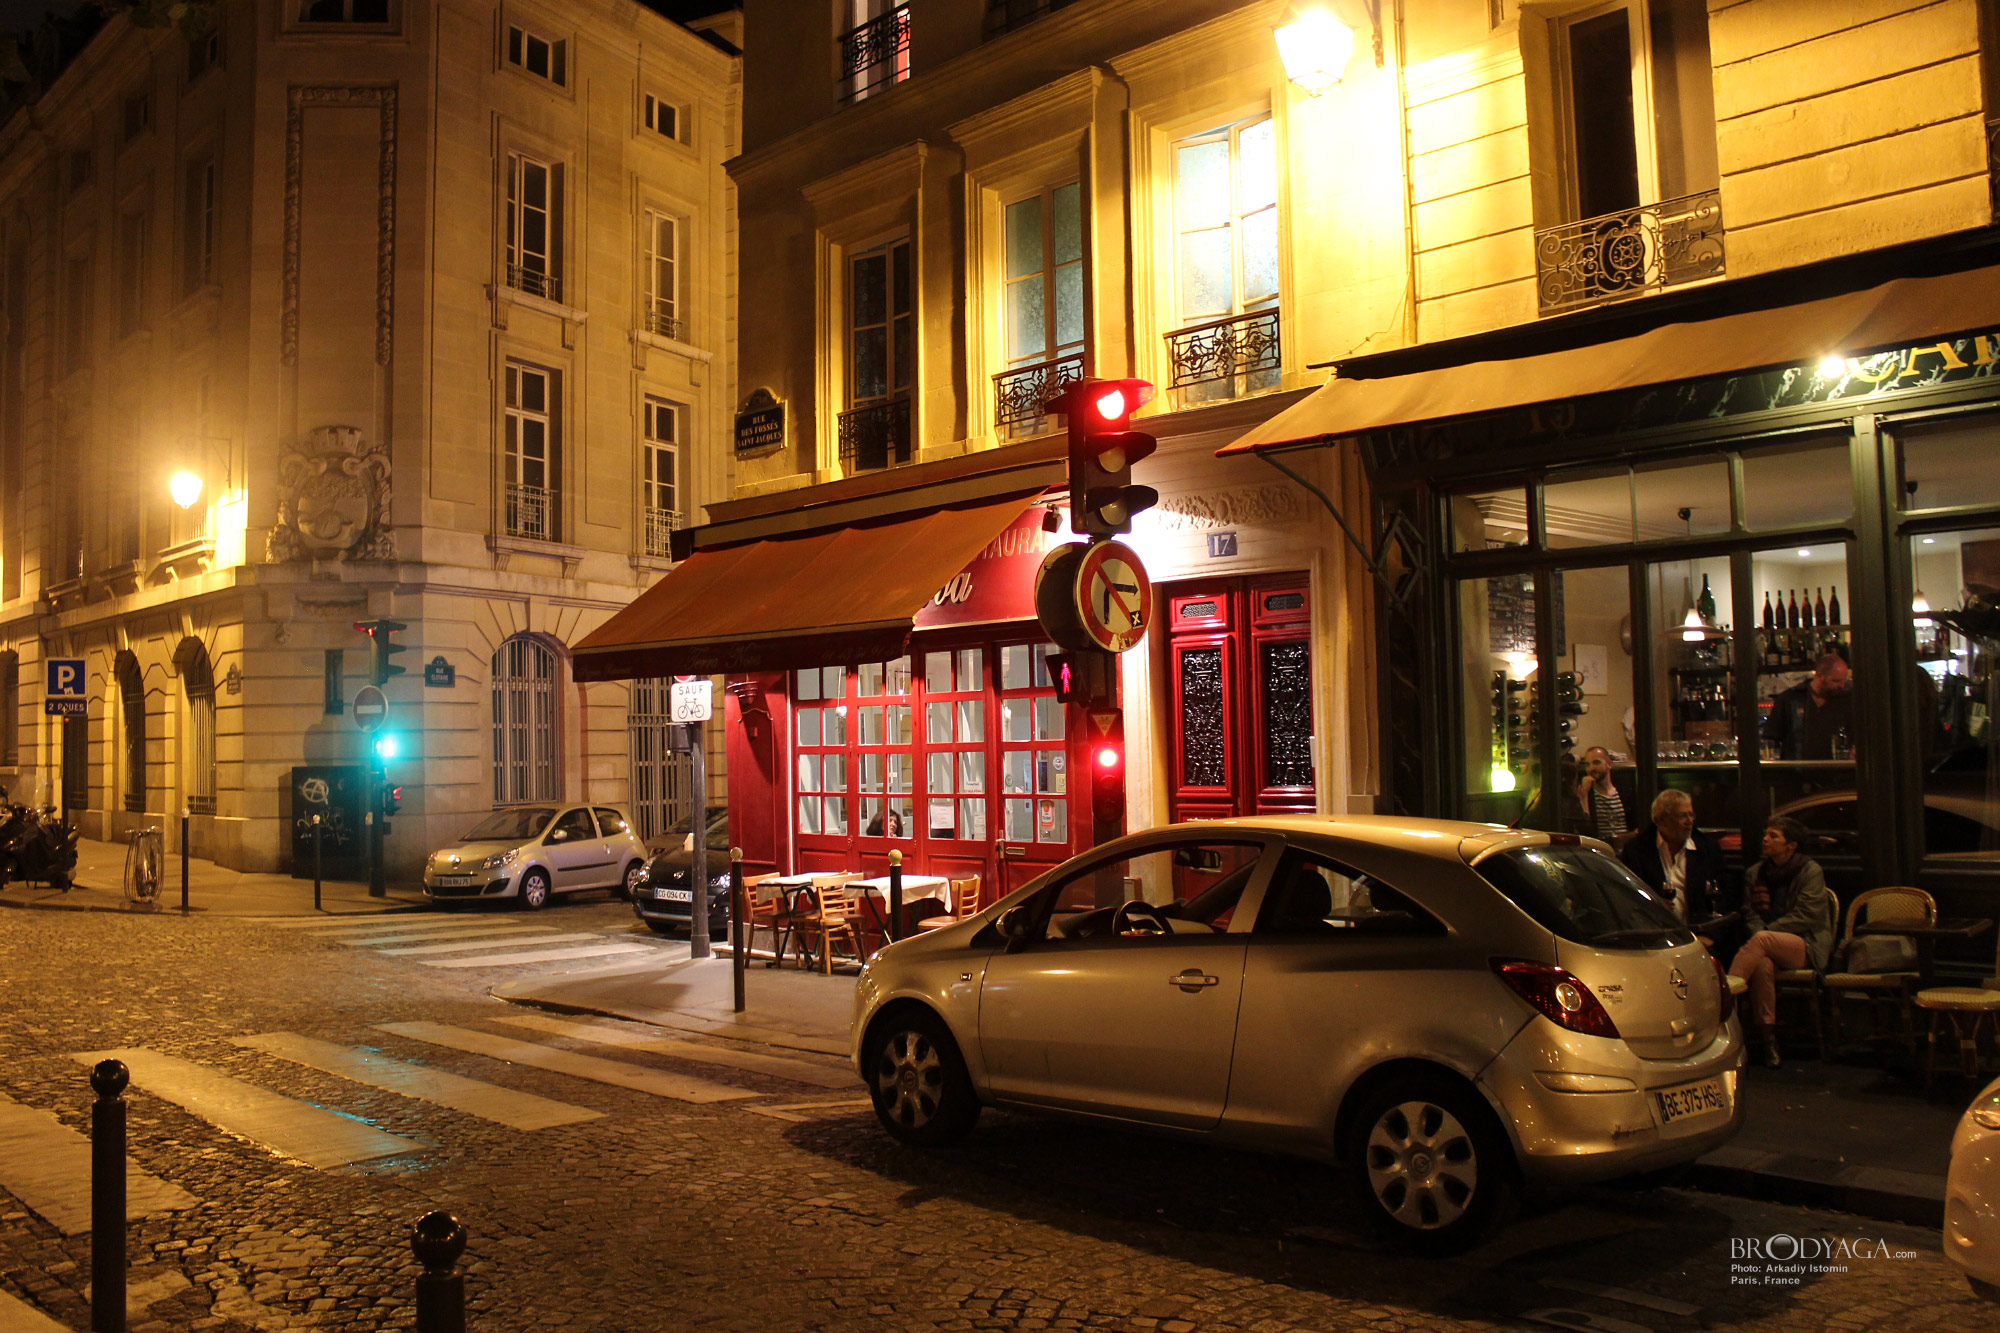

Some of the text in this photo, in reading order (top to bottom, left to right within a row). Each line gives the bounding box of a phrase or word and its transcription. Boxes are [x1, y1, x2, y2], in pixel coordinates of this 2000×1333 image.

[753, 415, 766, 425] RUE
[741, 427, 753, 437] DES
[737, 432, 782, 447] SAINT JACQUES
[1213, 534, 1231, 556] 17
[57, 665, 75, 689] P
[678, 684, 704, 695] SAUF
[48, 703, 54, 711] 2
